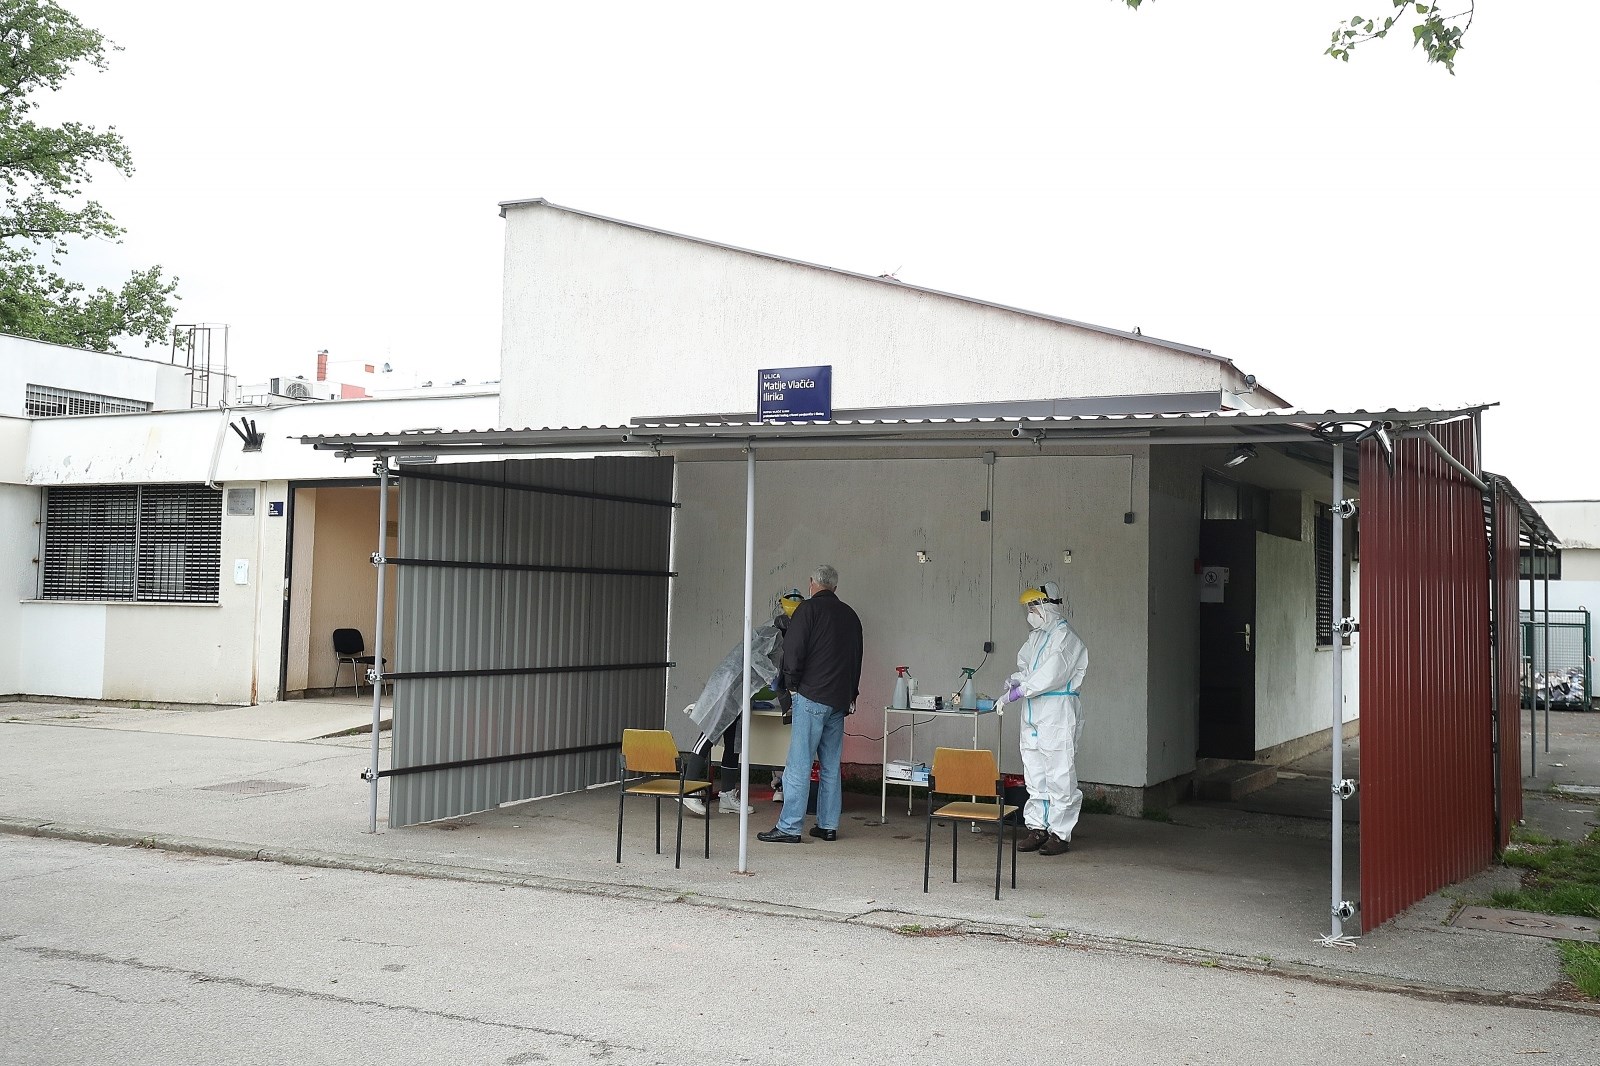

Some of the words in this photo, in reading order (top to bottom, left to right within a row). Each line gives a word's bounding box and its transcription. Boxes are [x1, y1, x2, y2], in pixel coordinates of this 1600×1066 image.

[763, 381, 786, 391] Matije
[788, 379, 815, 389] Vlačića
[763, 392, 784, 402] Ilirika
